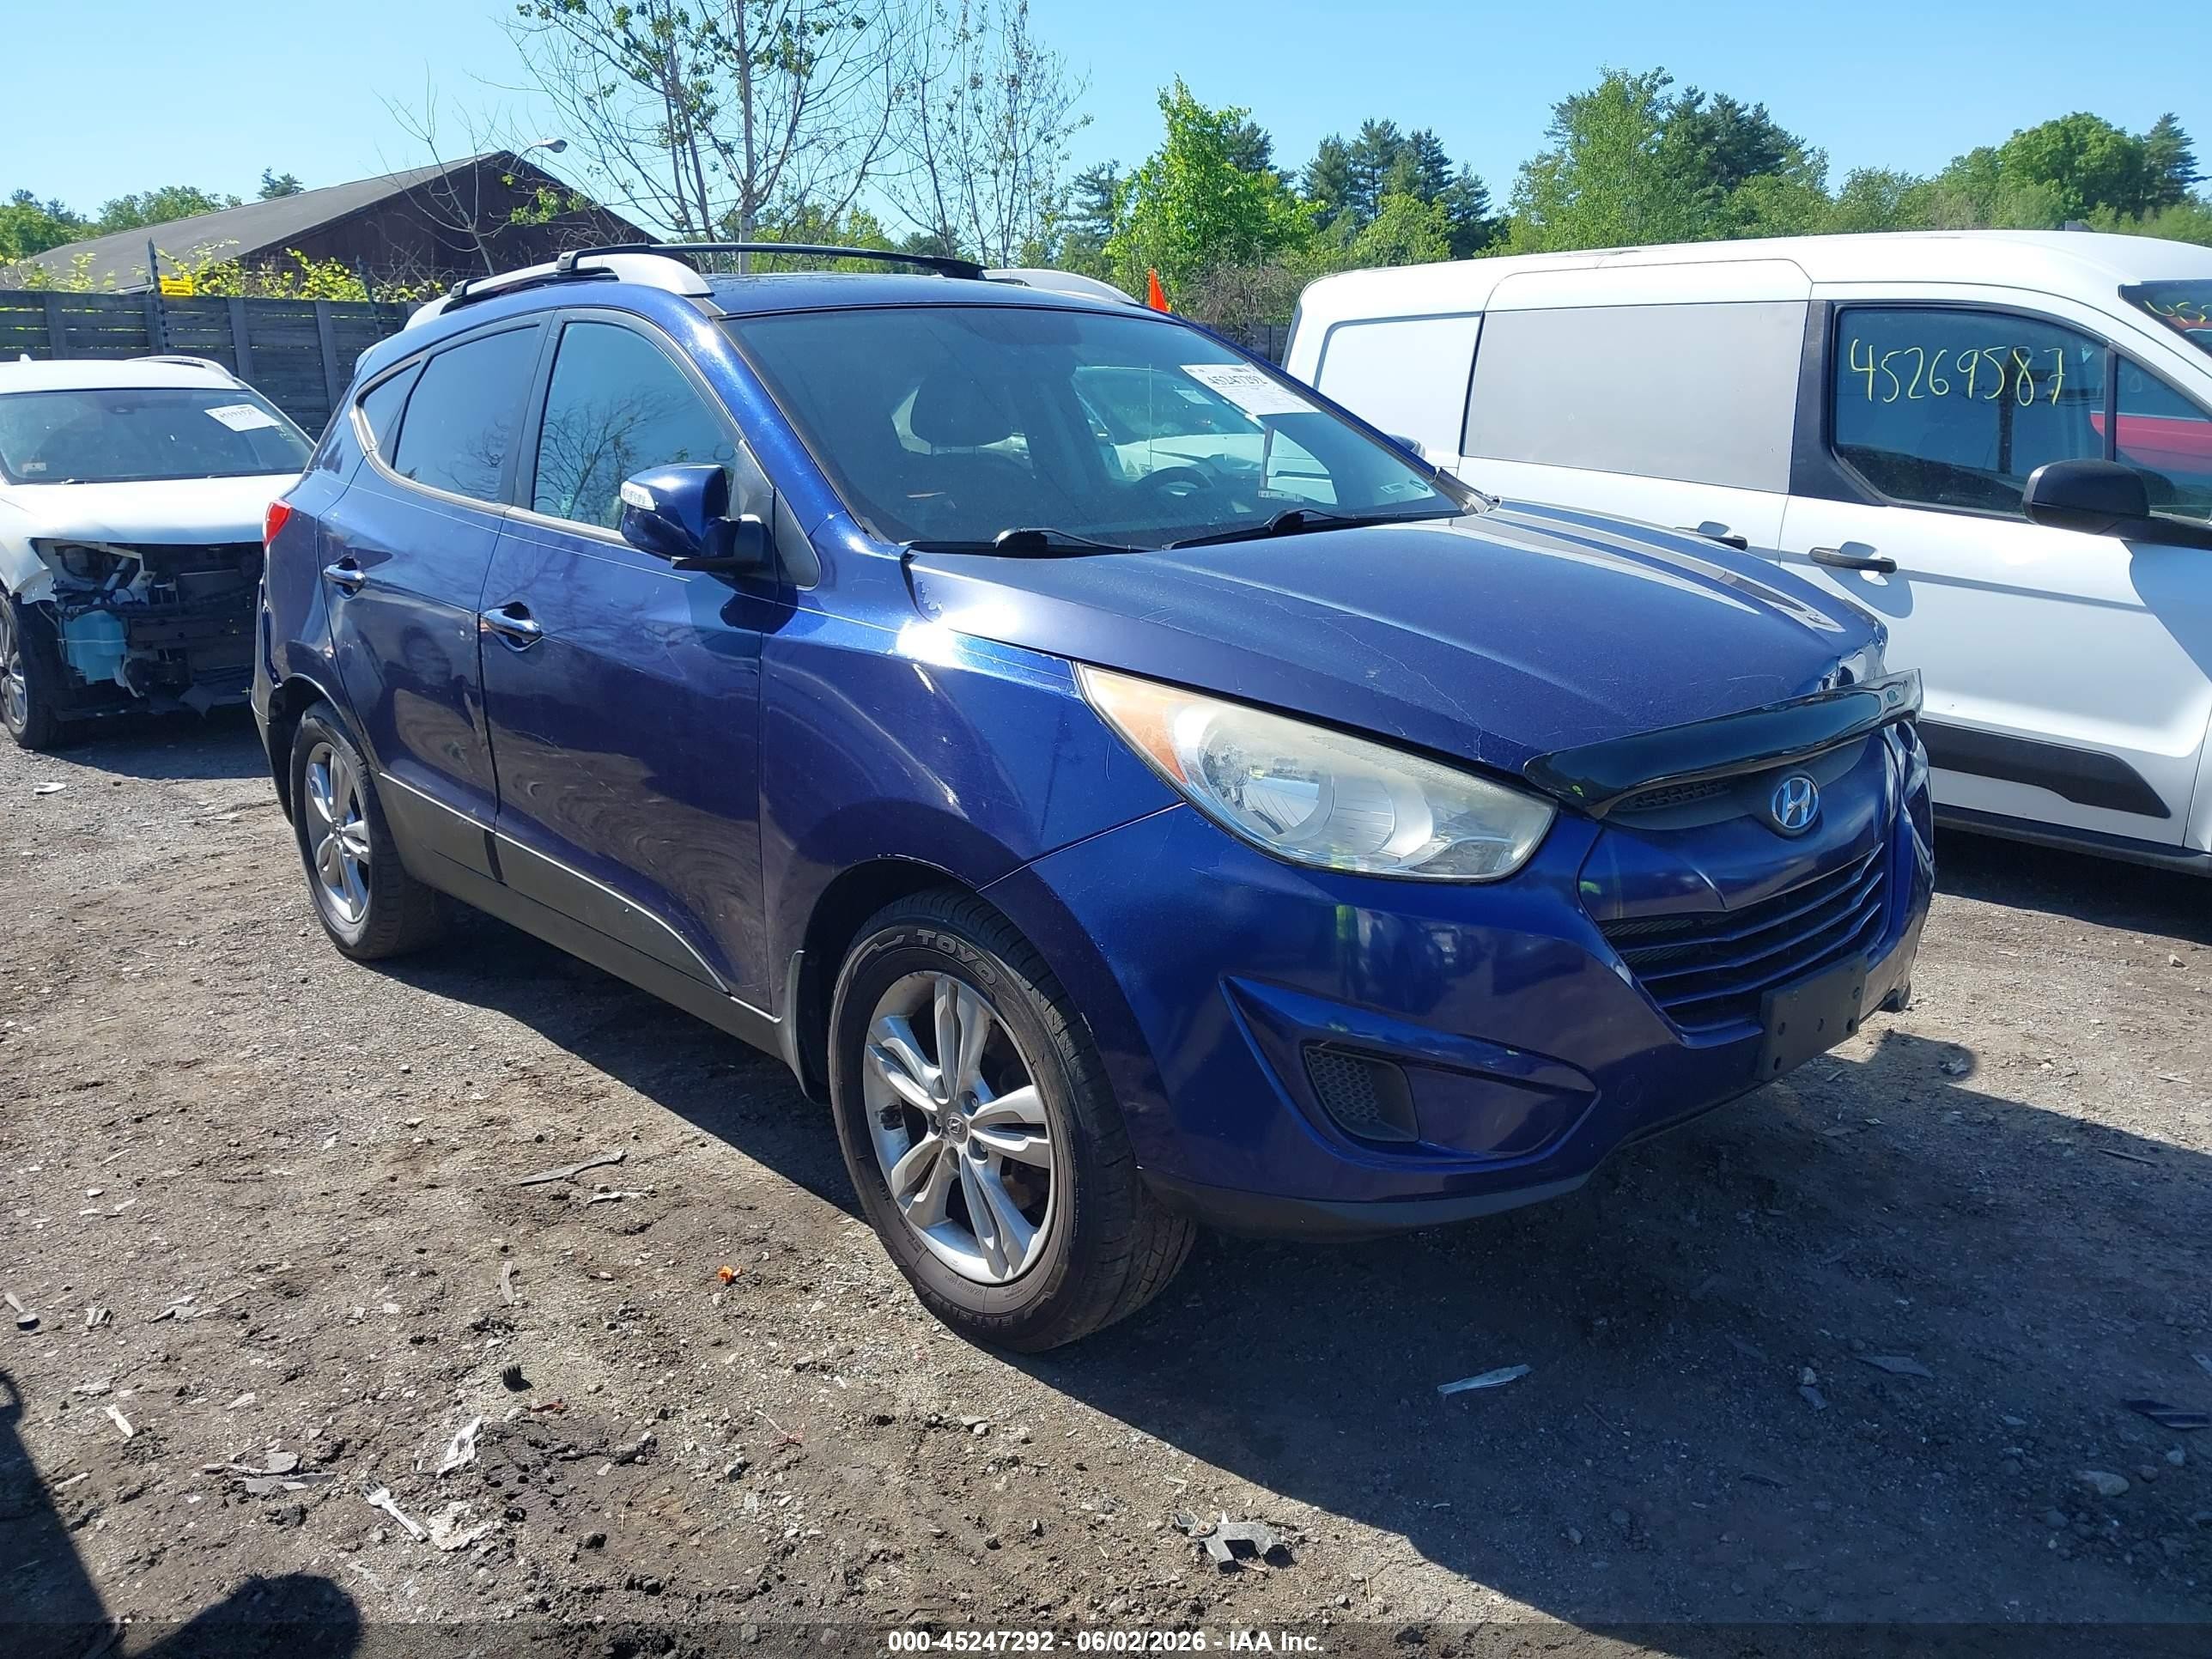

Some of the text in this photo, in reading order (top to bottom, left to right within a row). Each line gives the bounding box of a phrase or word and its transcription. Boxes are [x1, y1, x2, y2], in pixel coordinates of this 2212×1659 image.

[1206, 374, 1268, 386] 45247292
[1850, 338, 2066, 406] 45269587
[916, 929, 997, 985] TOYO
